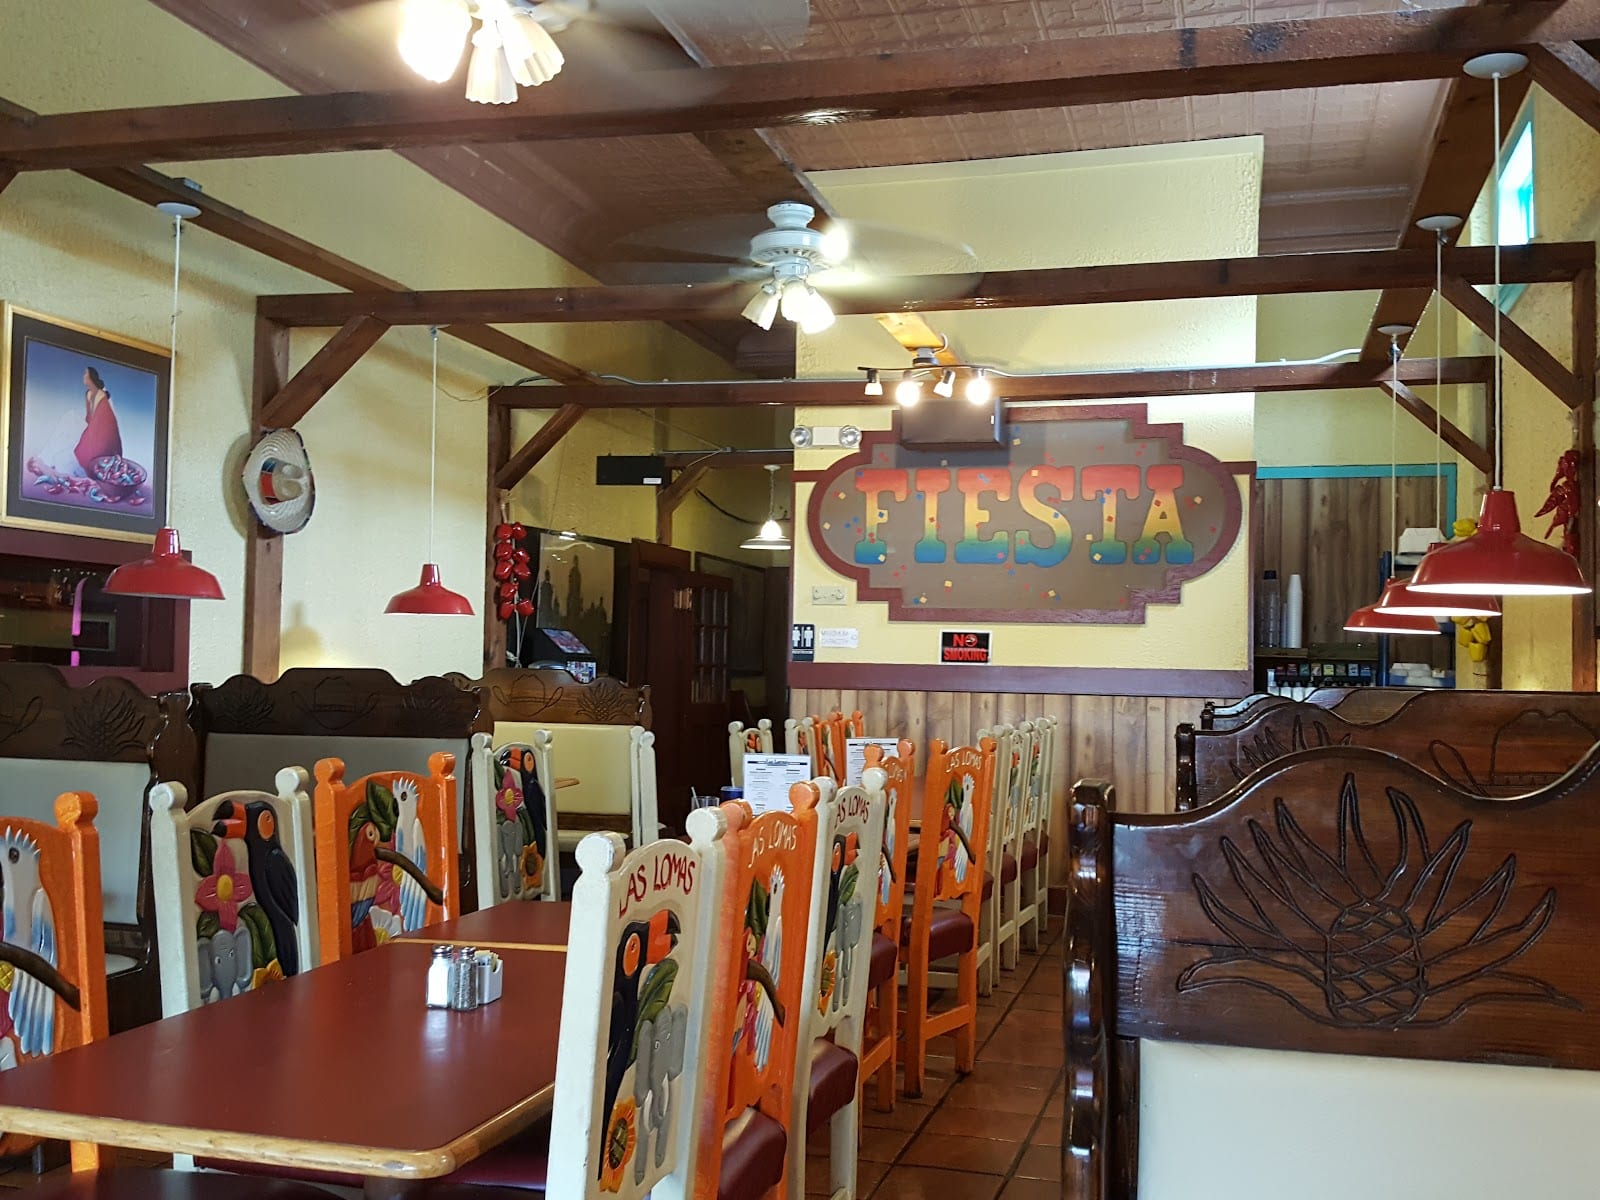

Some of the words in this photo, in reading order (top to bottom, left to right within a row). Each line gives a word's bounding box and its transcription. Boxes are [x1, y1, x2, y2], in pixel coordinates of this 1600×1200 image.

[855, 463, 1194, 568] FIESTA
[943, 647, 987, 661] SMOKING
[952, 633, 977, 647] NO
[961, 750, 983, 770] LOMAS
[848, 795, 870, 824] LOMAS
[748, 826, 764, 868] LAS
[768, 819, 797, 851] LOMAS
[618, 864, 648, 919] LAS
[653, 853, 696, 896] LOMAS
